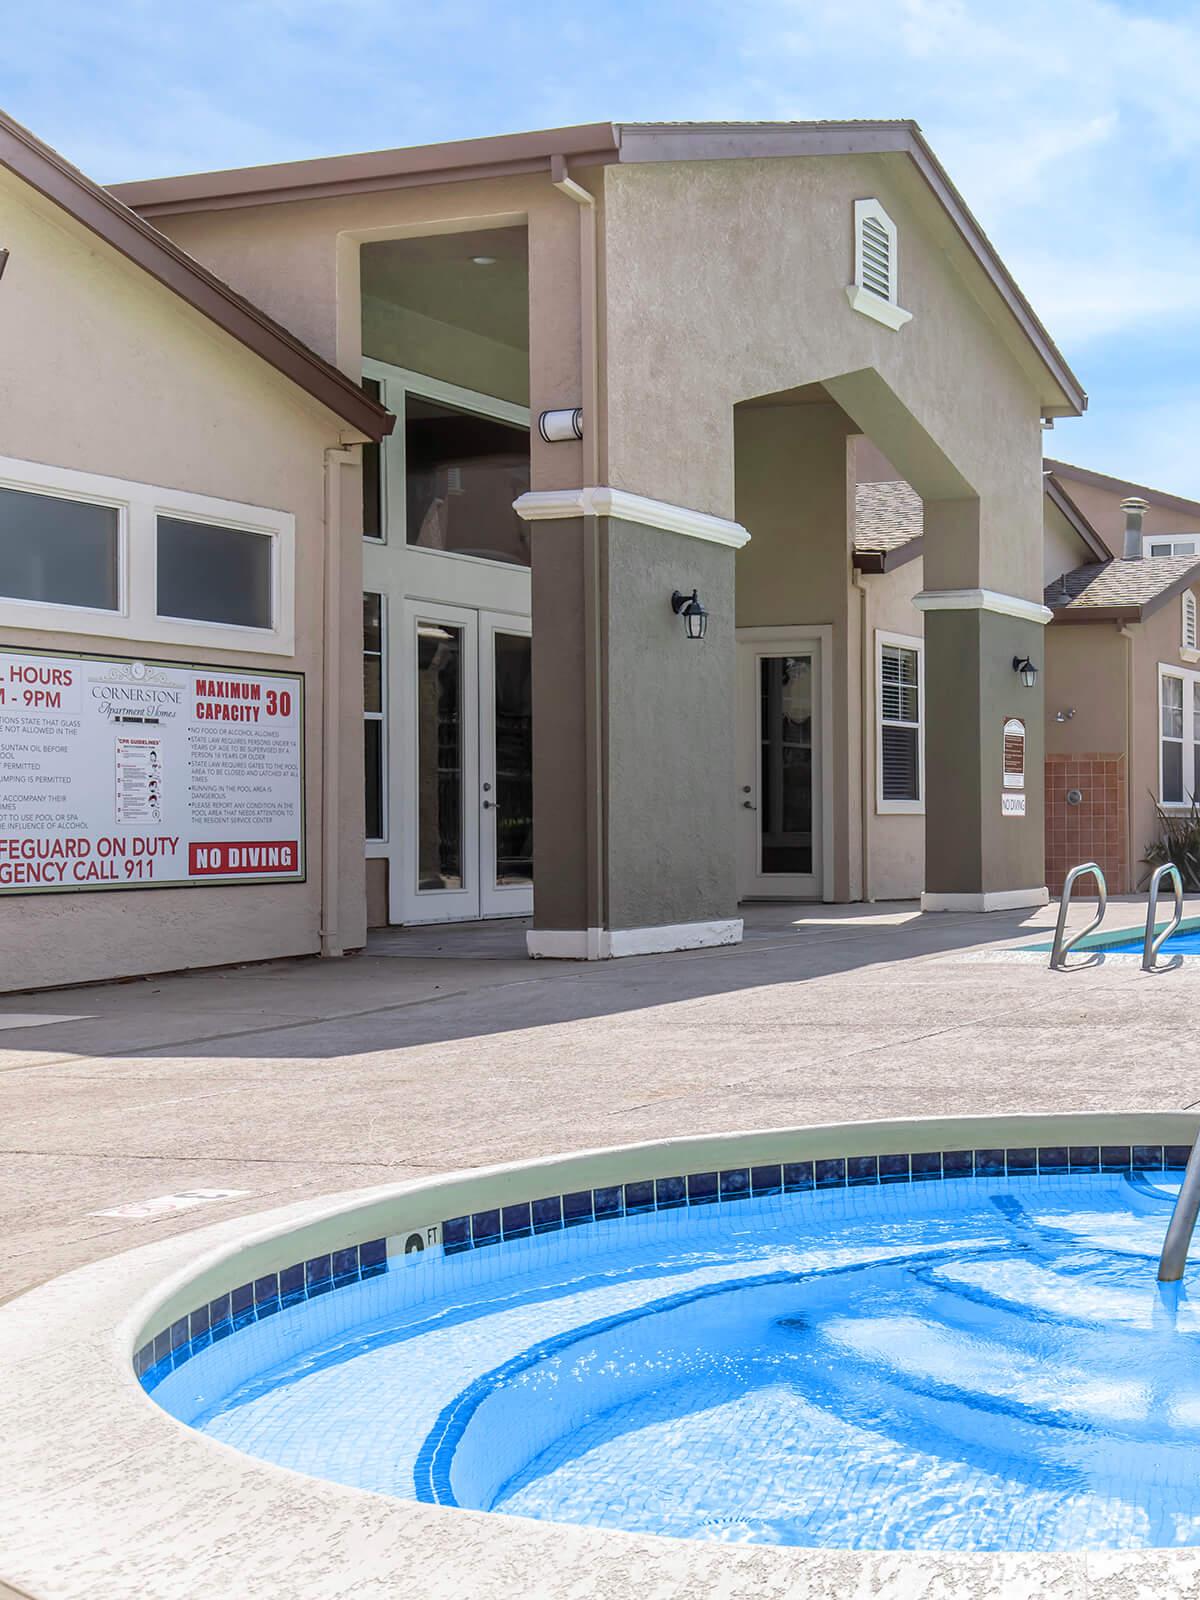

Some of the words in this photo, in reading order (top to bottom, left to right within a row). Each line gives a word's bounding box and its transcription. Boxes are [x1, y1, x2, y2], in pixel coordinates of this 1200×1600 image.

[10, 665, 73, 687] HOURS
[23, 689, 61, 708] 9PM
[92, 686, 182, 704] CORNERSTONE
[196, 679, 260, 700] MAXIMUM
[98, 701, 145, 719] Apartment
[146, 704, 177, 718] Homes
[196, 702, 260, 722] CAPACITY
[266, 690, 290, 716] 30
[20, 718, 41, 726] STATE
[42, 718, 59, 726] THAT
[60, 720, 81, 728] GLASS
[22, 726, 55, 734] ALLOWED
[65, 728, 78, 736] THE
[0, 744, 28, 752] SUNTAN
[30, 744, 42, 752] OIL
[208, 736, 220, 744] LAW
[222, 752, 238, 760] YEARS
[3, 762, 40, 770] PERMITTED
[28, 776, 34, 784] IS
[35, 776, 72, 784] PERMITTED
[1002, 799, 1009, 810] NO
[1010, 799, 1025, 811] DIVING
[8, 822, 45, 830] INFLUENCE
[46, 822, 56, 830] OF
[58, 822, 88, 830] ALCOHOL
[97, 837, 126, 857] ON
[132, 836, 180, 857] DUTY
[196, 848, 221, 868] NO
[228, 846, 292, 868] DIVING
[0, 861, 68, 884] GENCY
[73, 860, 119, 881] CALL
[124, 859, 153, 879] 911
[427, 1227, 438, 1246] FT
